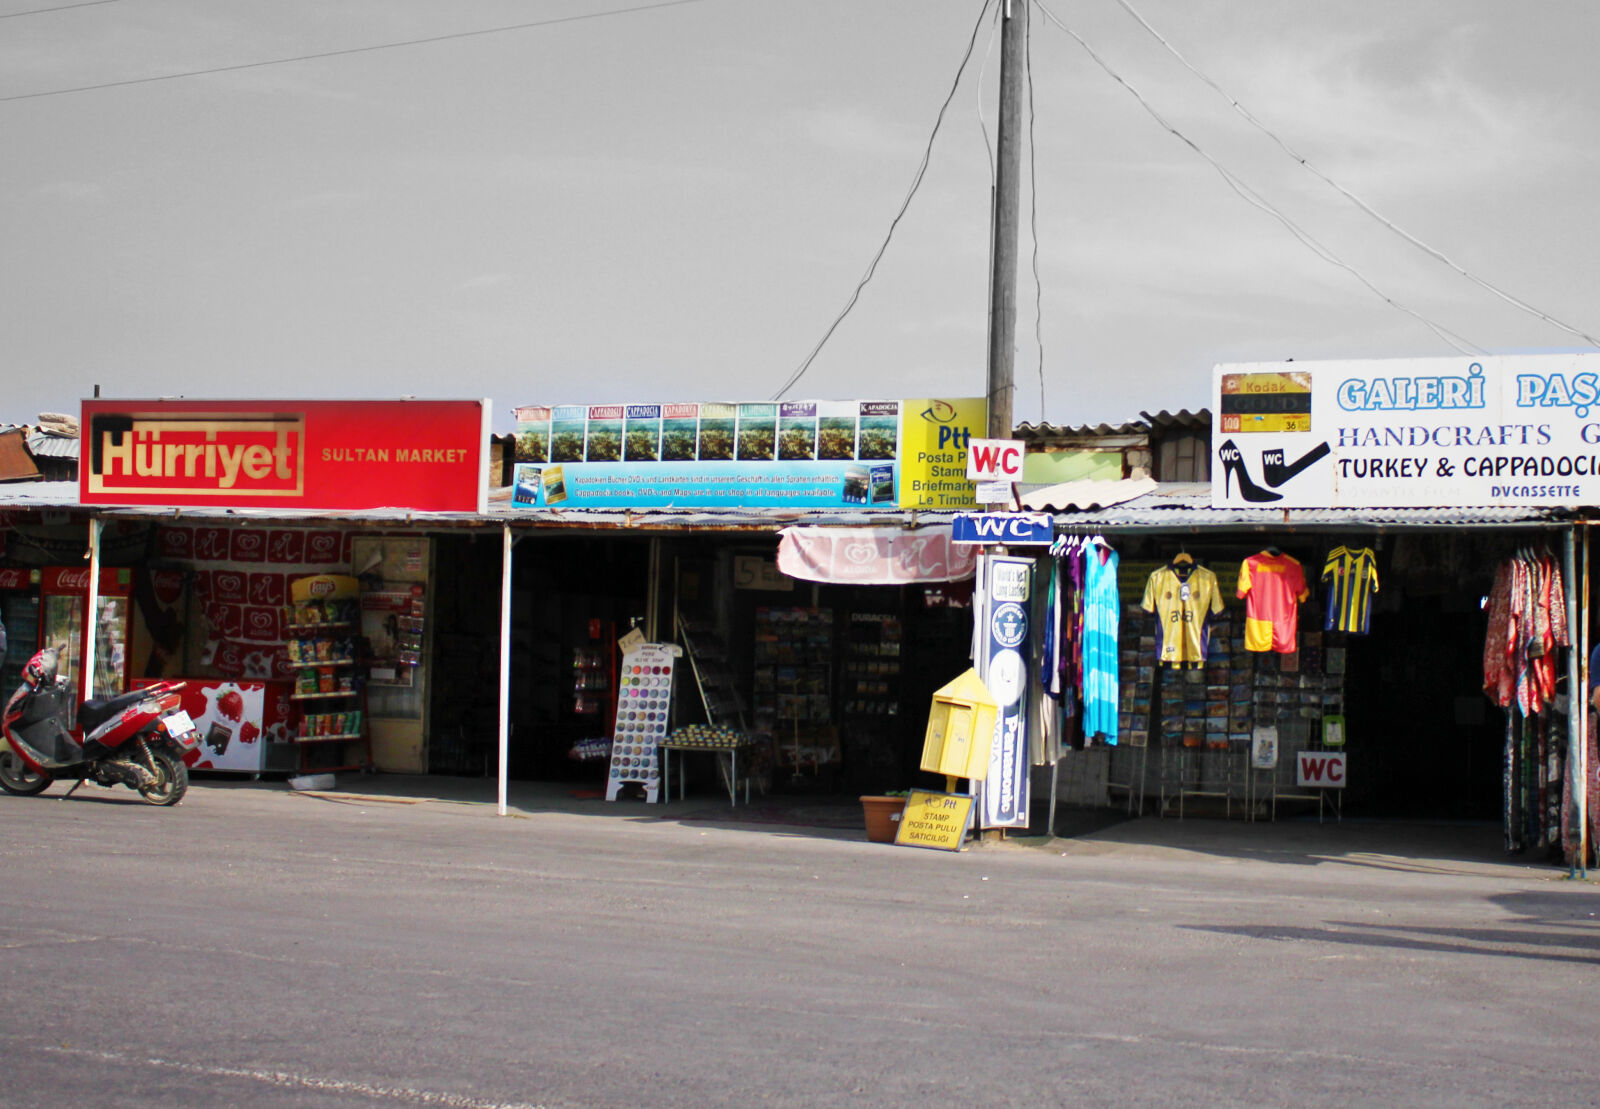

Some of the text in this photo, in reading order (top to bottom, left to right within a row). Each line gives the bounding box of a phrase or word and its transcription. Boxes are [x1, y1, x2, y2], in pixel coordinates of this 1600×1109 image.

[1246, 382, 1287, 393] Kodak
[1337, 362, 1600, 418] GALERİ PAŞ
[1223, 416, 1241, 430] 100
[1285, 421, 1297, 430] 36
[938, 425, 972, 450] Ptt
[1338, 424, 1551, 447] HANDCRAFTS
[102, 429, 292, 488] Hürriyet
[321, 448, 468, 464] SULTAN MARKET
[918, 452, 968, 463] Posta P
[972, 445, 1020, 475] WC
[1220, 449, 1240, 461] WC
[1264, 454, 1282, 465] WC
[1338, 455, 1600, 478] TURKEY & CAPPADOCI
[912, 480, 977, 491] Briefmark
[919, 494, 977, 505] Le Timbr
[973, 517, 1033, 537] WC
[1001, 714, 1018, 814] Panasonic
[1301, 757, 1343, 782] WC
[944, 799, 957, 809] Ptt
[923, 812, 950, 822] STAMP
[908, 820, 957, 833] POSTA PULU
